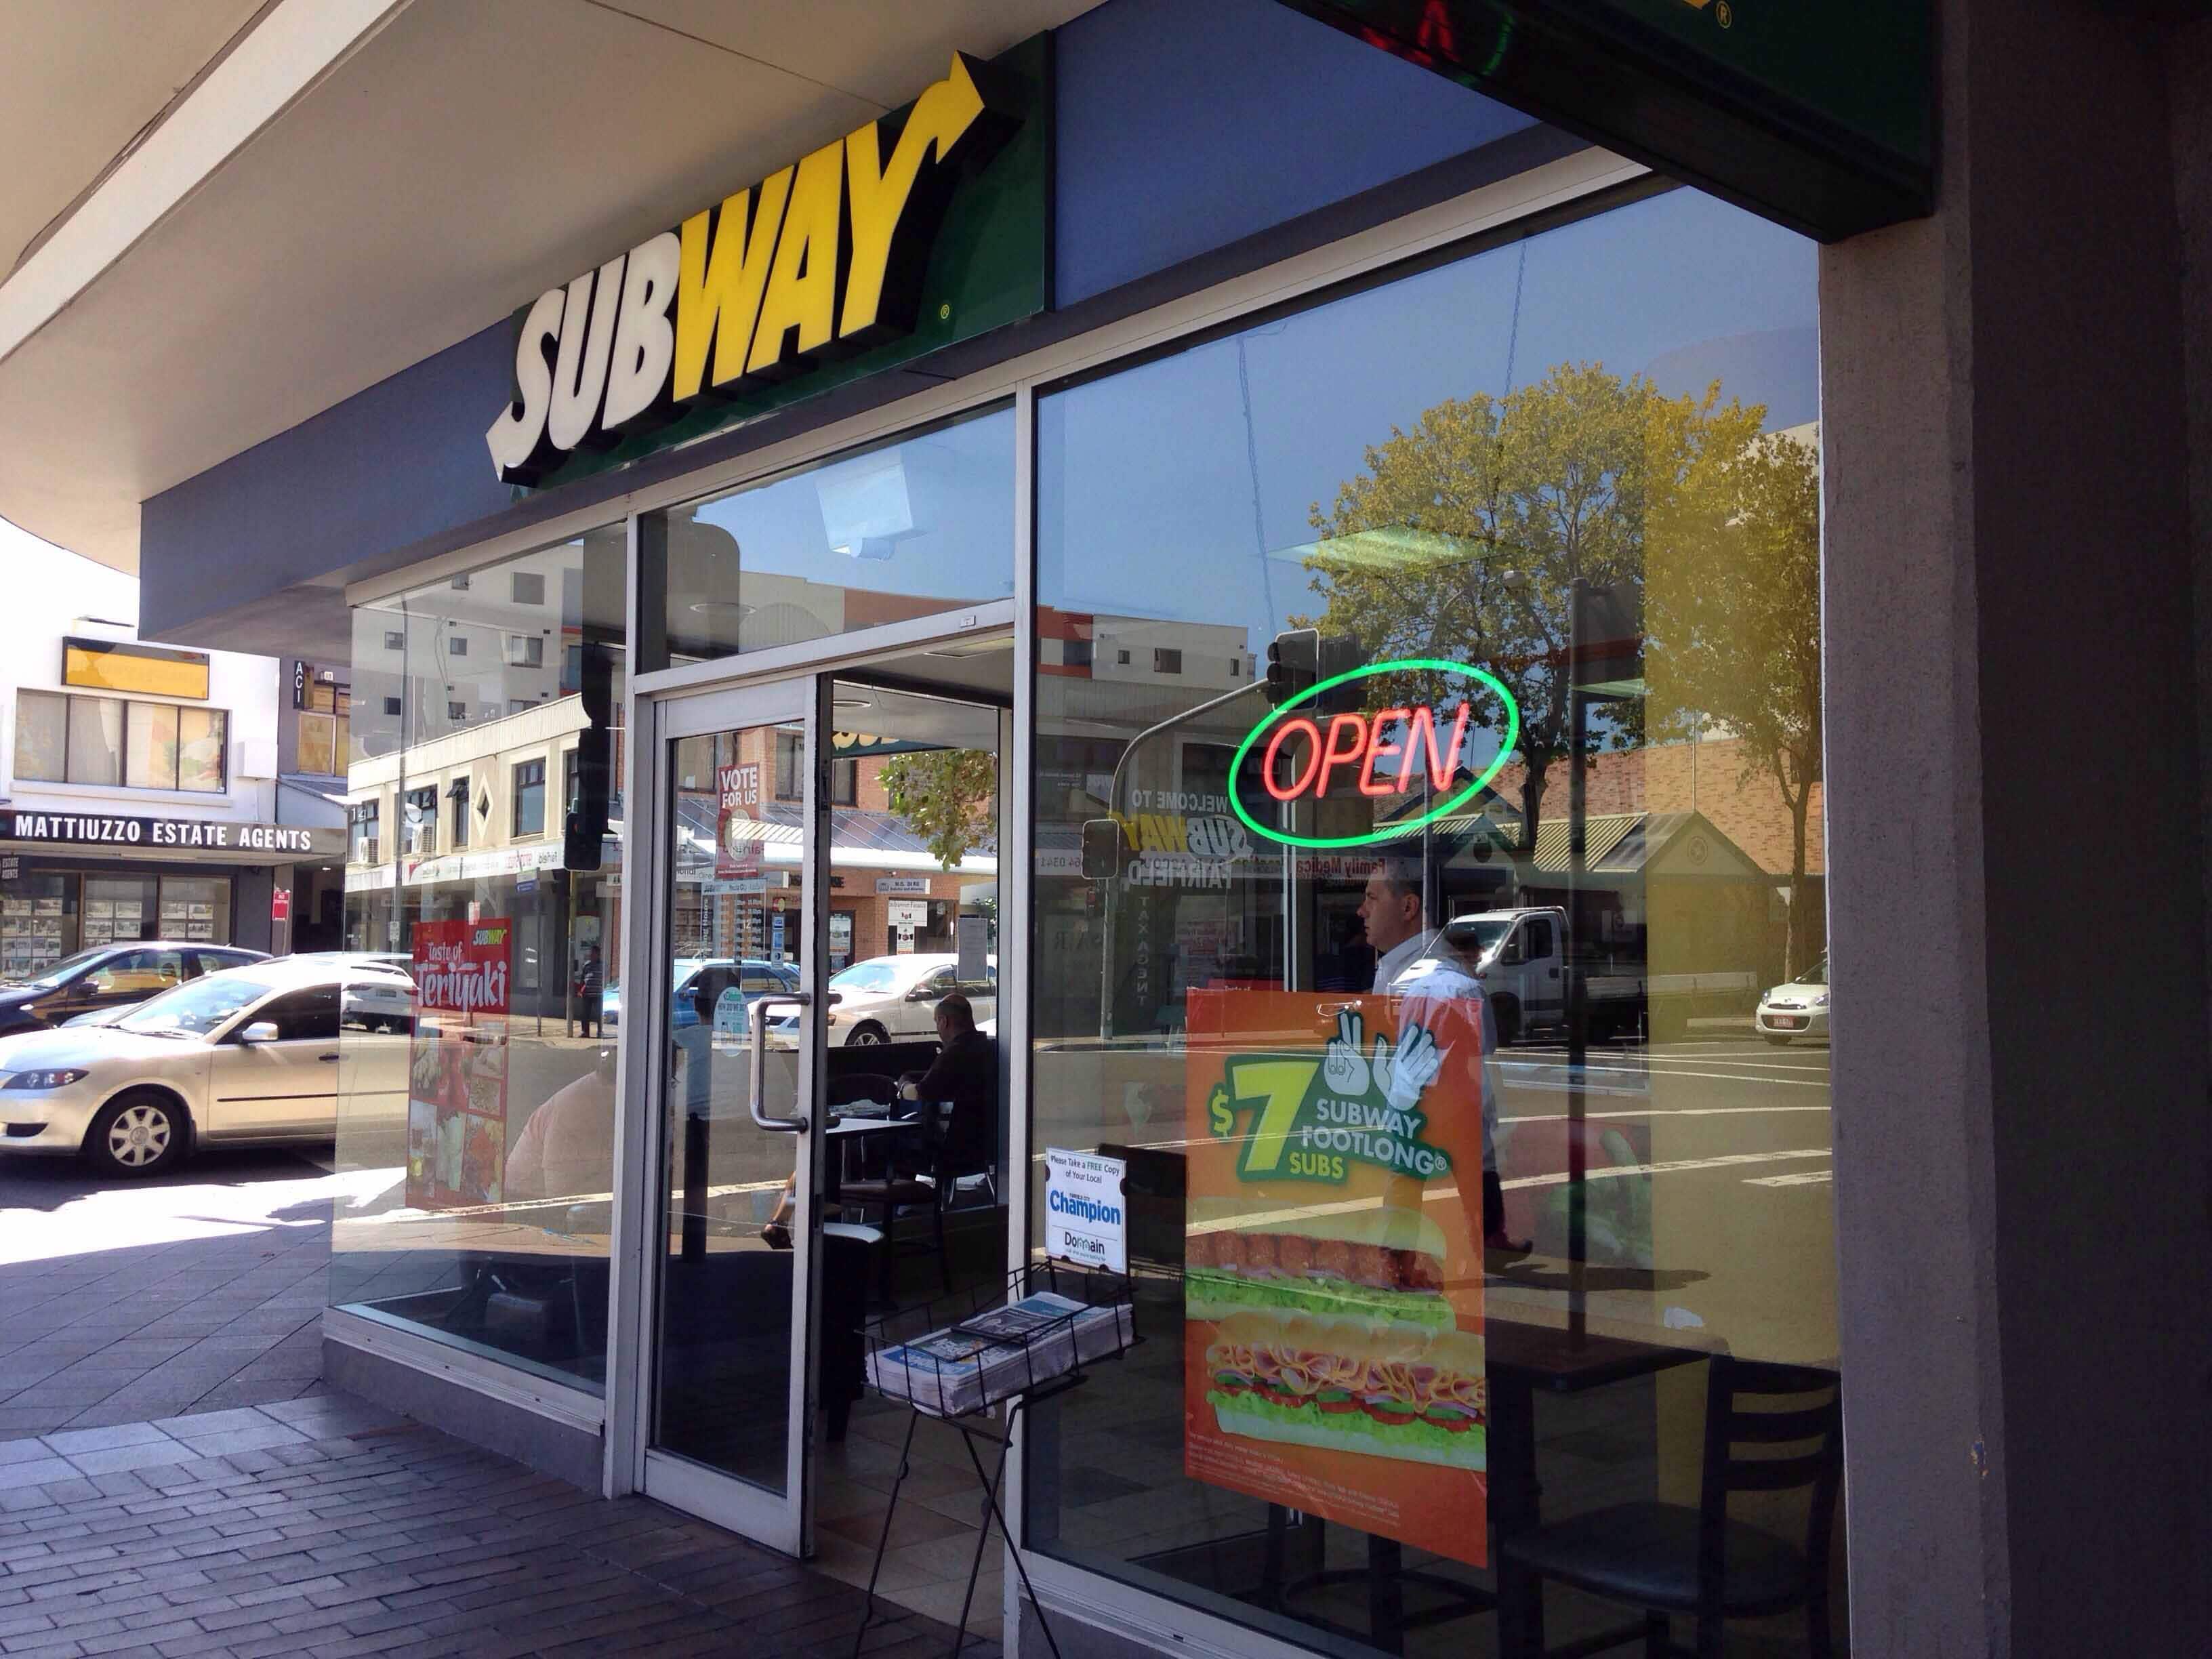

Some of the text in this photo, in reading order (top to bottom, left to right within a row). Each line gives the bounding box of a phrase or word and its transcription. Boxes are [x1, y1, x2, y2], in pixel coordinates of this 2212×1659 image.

[485, 51, 985, 482] SUBWAY
[1264, 701, 1469, 800] OPEN
[721, 767, 757, 791] VOTE
[722, 790, 757, 808] FOR US
[15, 815, 312, 851] MATTIUZZO ESTATE AGENTS
[473, 928, 507, 945] SUBWAY
[428, 941, 463, 962] Taste of
[415, 961, 506, 1019] Teriyaki
[1317, 1099, 1421, 1139] SUBWAY
[1050, 1155, 1067, 1166] Please
[1068, 1158, 1081, 1169] Take
[1087, 1161, 1103, 1172] FREE
[1104, 1164, 1120, 1177] Copy
[1072, 1171, 1085, 1181] Your
[1086, 1174, 1102, 1184] Local
[1290, 1152, 1345, 1179] SUBS
[1050, 1189, 1121, 1225] Champion
